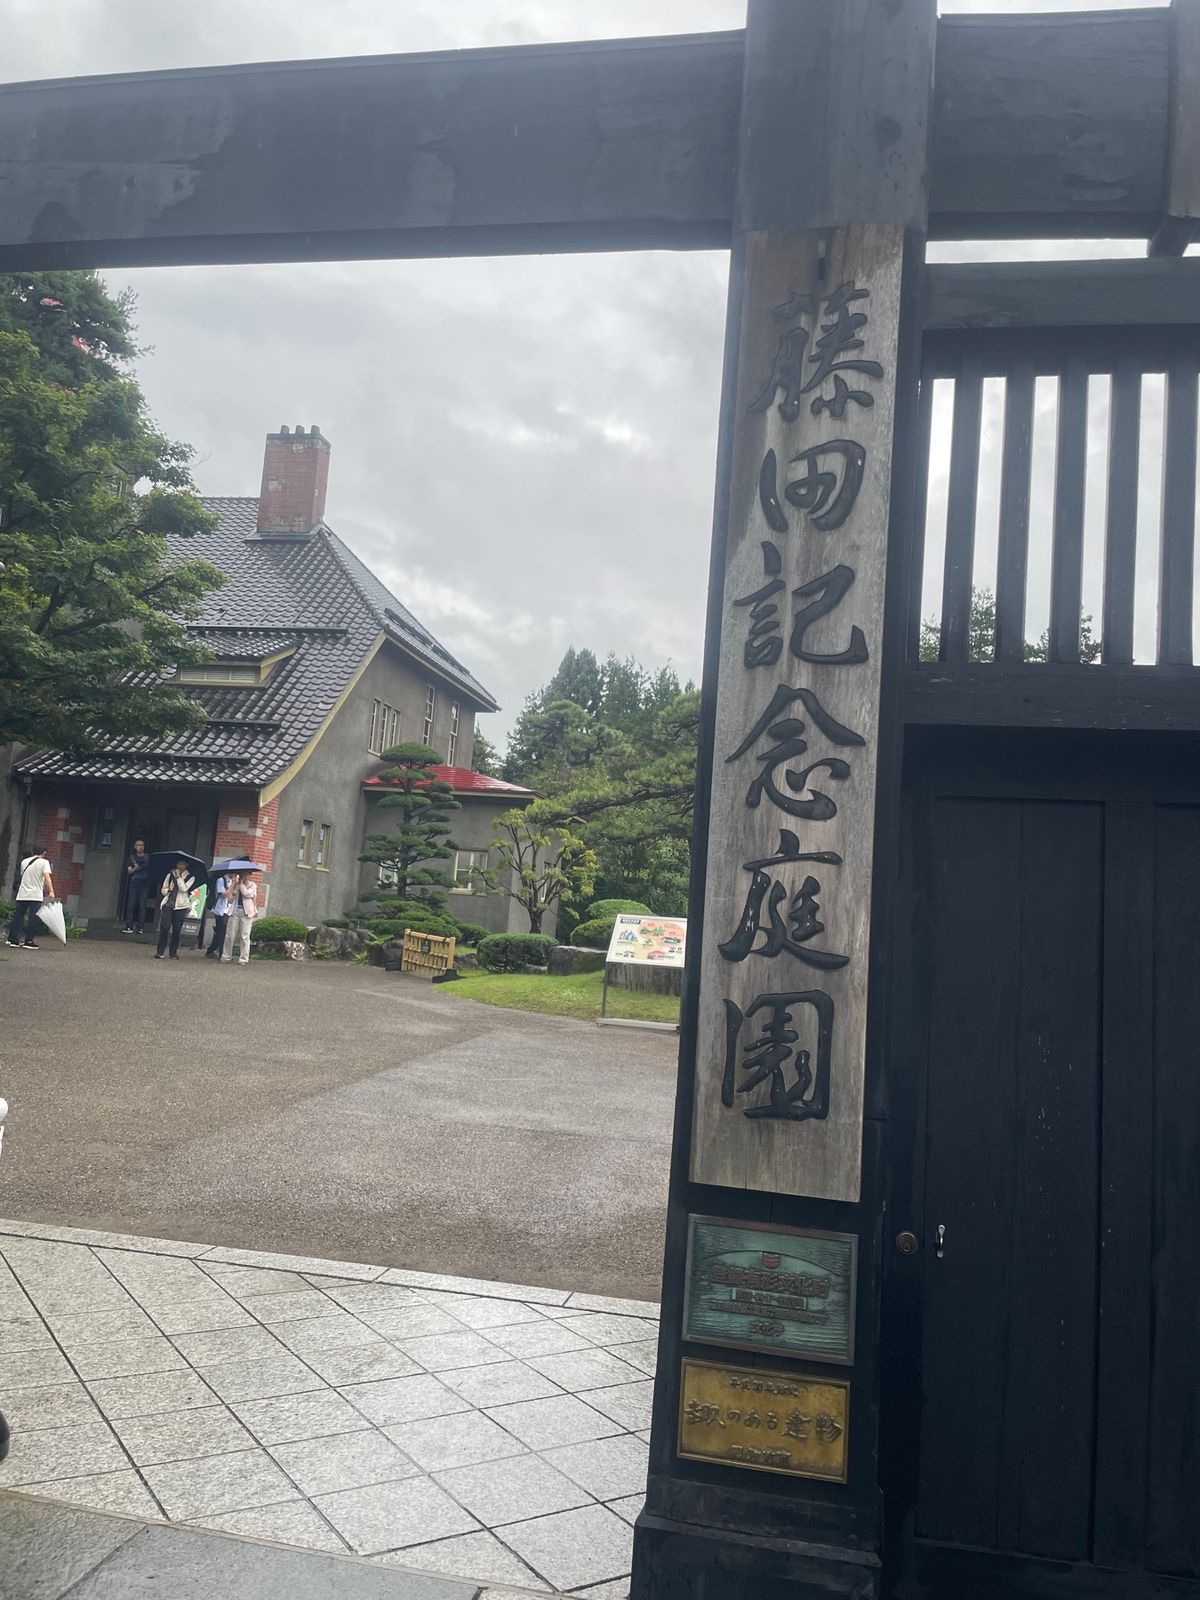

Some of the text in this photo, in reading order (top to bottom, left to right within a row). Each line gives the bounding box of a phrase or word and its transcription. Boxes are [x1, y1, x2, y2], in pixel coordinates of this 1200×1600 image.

[719, 281, 884, 1121] 藤田記念庭園
